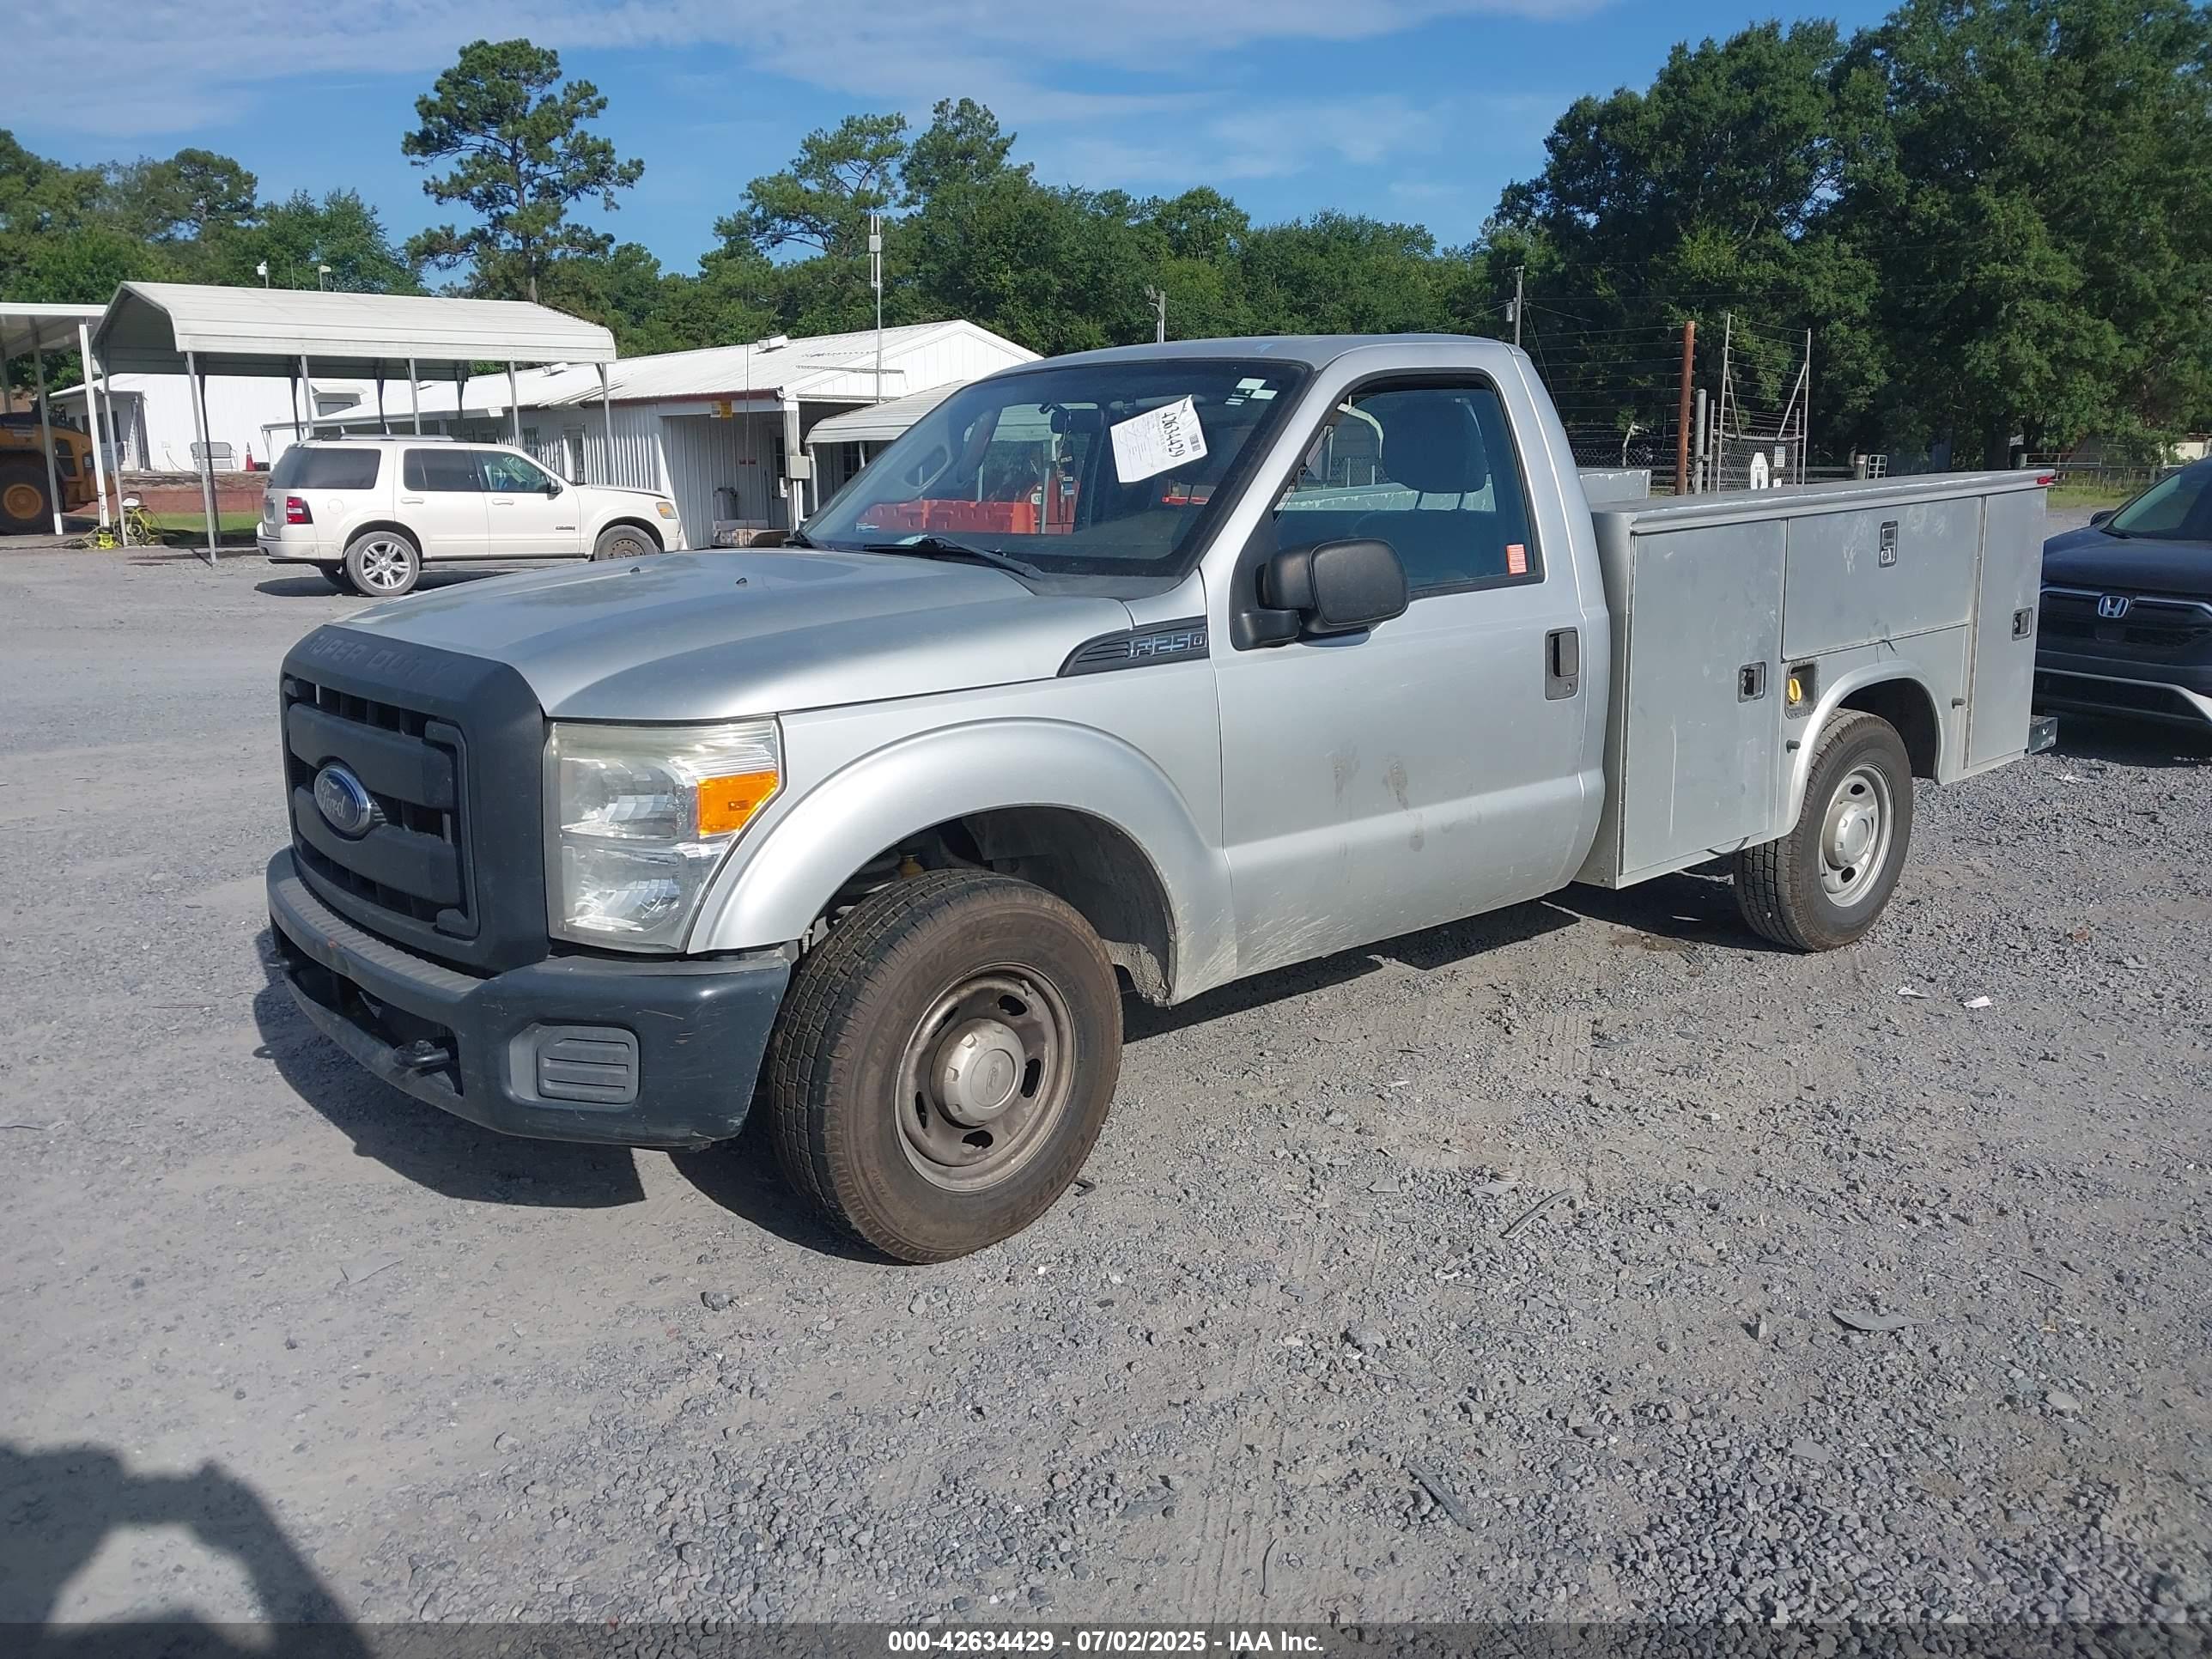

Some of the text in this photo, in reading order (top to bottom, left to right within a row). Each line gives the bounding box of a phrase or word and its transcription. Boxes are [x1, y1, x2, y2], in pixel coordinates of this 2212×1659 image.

[1161, 412, 1186, 458] 42634429
[307, 634, 454, 681] SUPER DUTY
[321, 777, 347, 818] Ford
